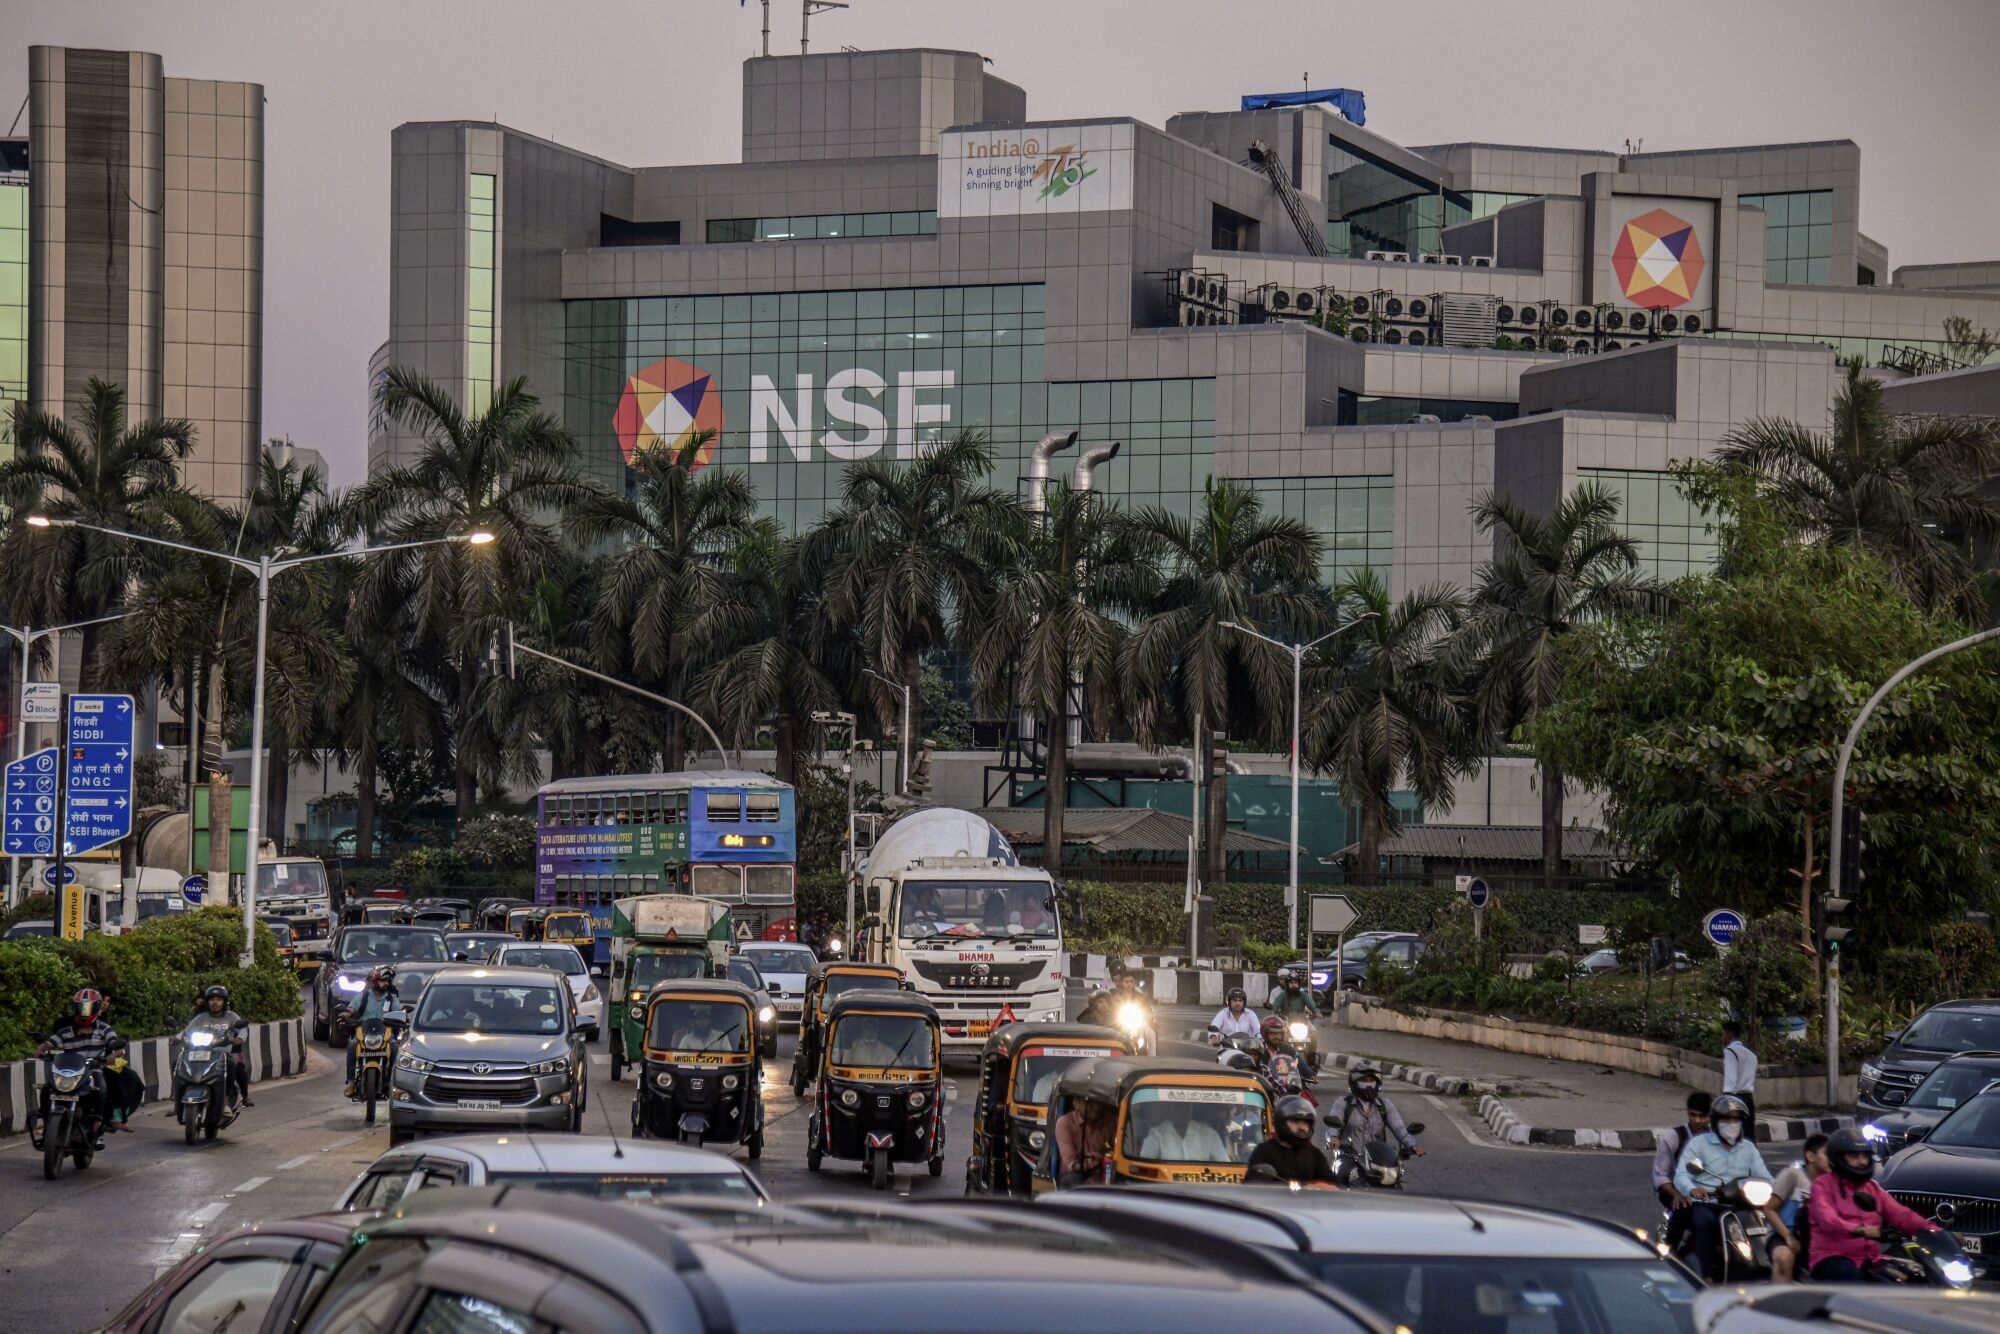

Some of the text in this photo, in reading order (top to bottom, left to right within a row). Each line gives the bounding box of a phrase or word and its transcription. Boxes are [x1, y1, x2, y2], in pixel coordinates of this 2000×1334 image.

[967, 138, 1084, 187] India@ 75
[966, 164, 1039, 178] A guiding light,
[966, 178, 1033, 191] shining bright
[750, 367, 955, 463] NSE
[25, 700, 34, 713] G
[73, 729, 104, 739] SIDBI
[71, 777, 111, 787] ONGC
[70, 826, 120, 836] SEBI Bhavan
[69, 891, 78, 928] Avenue
[958, 952, 995, 962] BHAMRA
[949, 976, 1011, 986] EICHER
